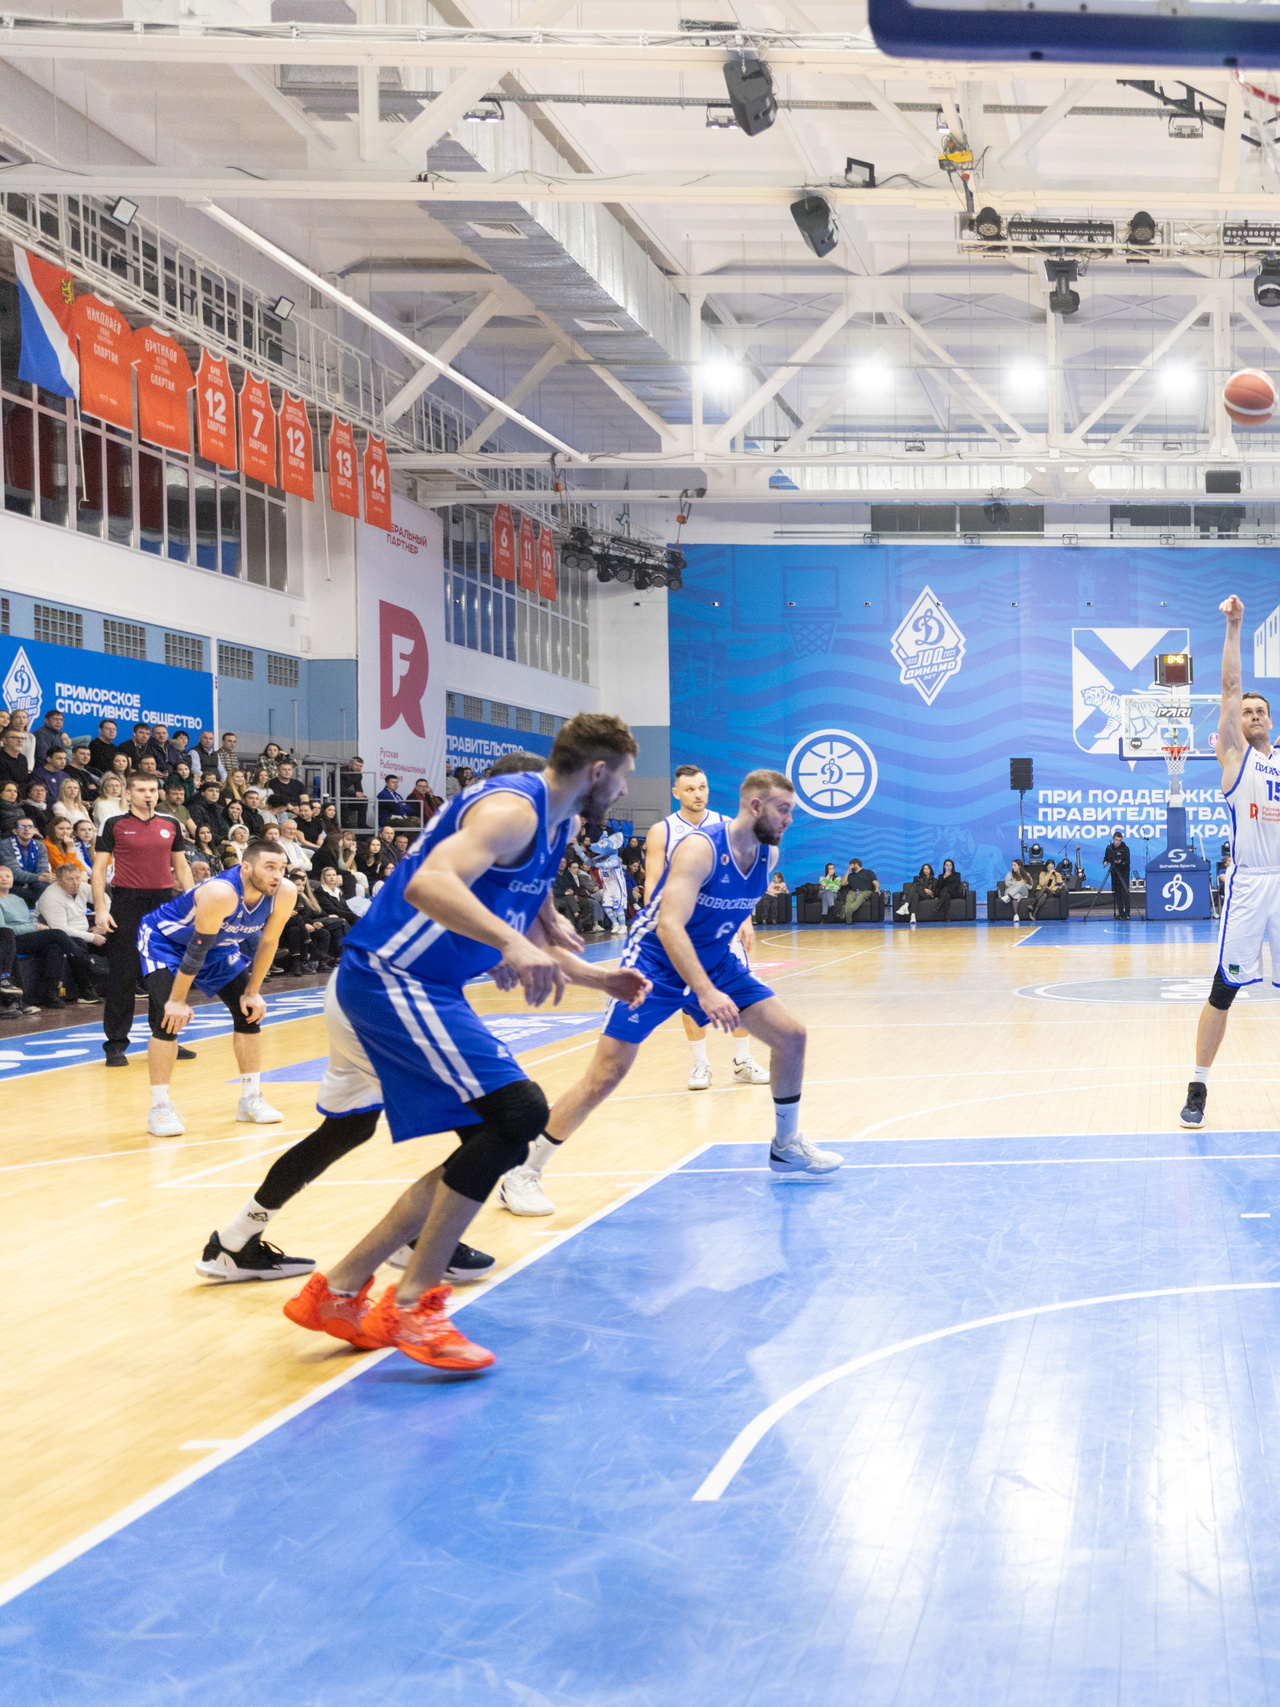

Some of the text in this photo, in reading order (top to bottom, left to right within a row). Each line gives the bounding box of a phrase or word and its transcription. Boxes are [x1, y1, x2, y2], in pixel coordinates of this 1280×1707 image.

[94, 343, 119, 365] СПАРТАК
[150, 373, 175, 392] СПАРТАК
[205, 388, 226, 423] 12
[251, 409, 264, 438] 7
[286, 426, 305, 459] 12
[336, 449, 352, 478] 13
[370, 464, 386, 494] 14
[386, 533, 419, 555] ПАРТНЕР
[501, 527, 508, 548] 6
[523, 539, 532, 562] 11
[542, 548, 552, 571] 10
[905, 661, 956, 679] ДИНАМО
[55, 682, 141, 708] ПРИМОРСКОЕ
[55, 698, 202, 730] СПОРТИВНОЕ ОБЩЕСТВО
[1156, 707, 1192, 718] PARI
[380, 747, 399, 760] Русская
[1038, 789, 1082, 804] ПРИ
[1038, 807, 1228, 822] ПРАВИТЕЛЬТВА
[1018, 825, 1230, 840] ПРИМОРСКОГ КРА
